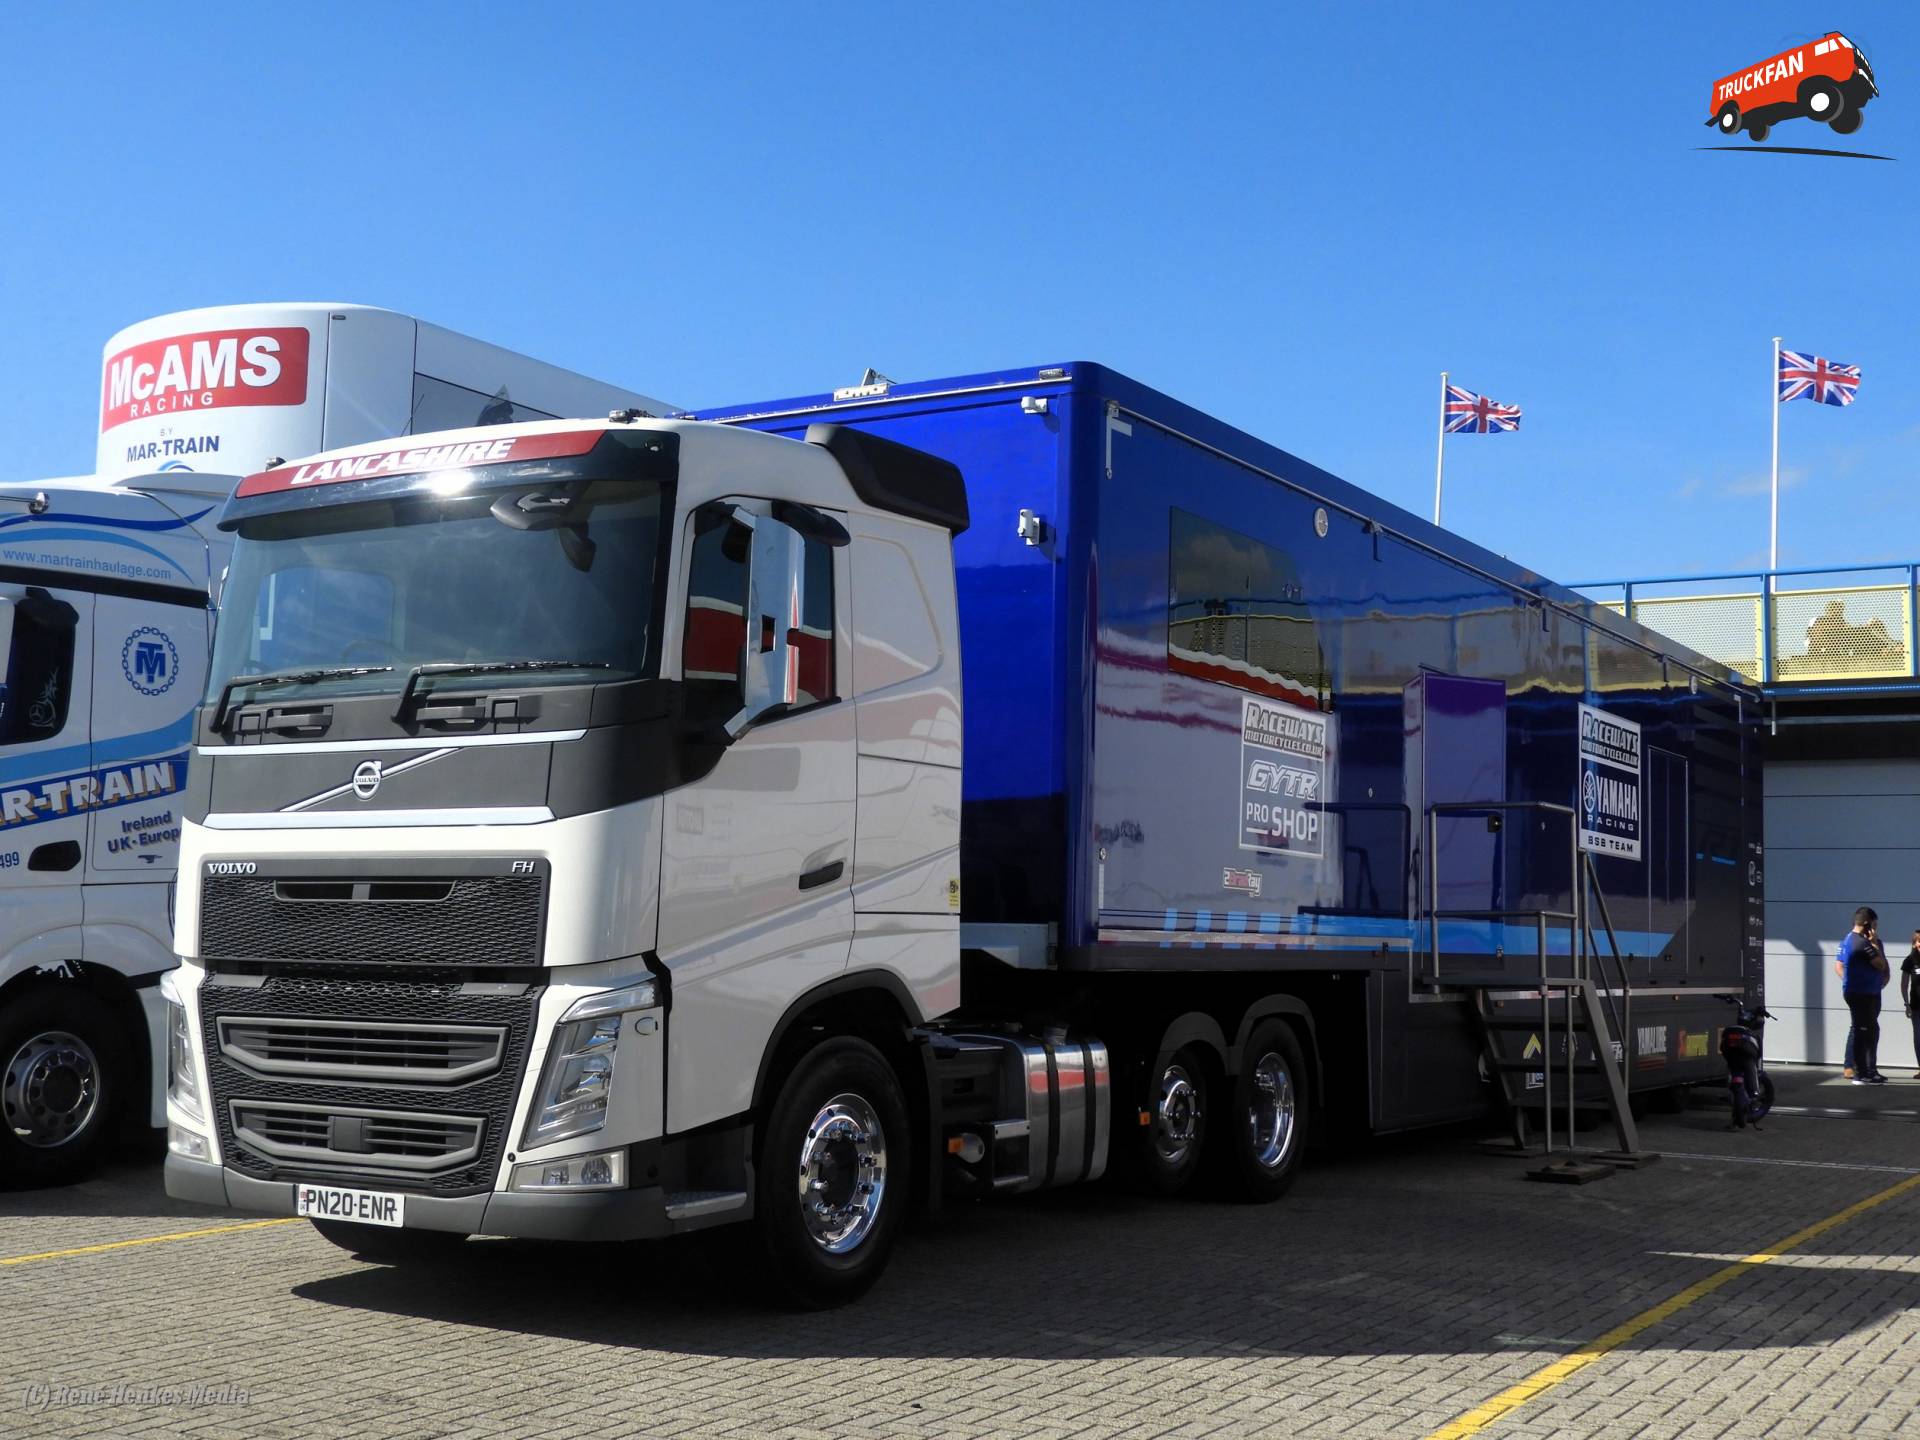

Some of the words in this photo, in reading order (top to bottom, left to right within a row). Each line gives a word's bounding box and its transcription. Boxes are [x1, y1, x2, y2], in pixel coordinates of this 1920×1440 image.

[109, 336, 282, 410] McAMS
[130, 391, 213, 418] RACING
[127, 435, 220, 463] MAR-TRAIN
[290, 438, 517, 484] LANCASHIRE
[3, 550, 172, 580] www.martrainhaulage.com
[1247, 703, 1324, 744] RACEWAYS
[1582, 711, 1639, 753] RACEWAYS
[1244, 729, 1323, 758] MOTORCYCLES.CO.UK
[0, 761, 176, 825] R-TRAIN
[354, 775, 379, 784] VOLVO
[1247, 760, 1320, 801] GYTR
[1596, 775, 1638, 821] YAMAHA
[121, 810, 173, 834] Ireland
[1246, 802, 1269, 824] PRO
[1271, 806, 1318, 842] SHOP
[1587, 815, 1634, 831] RACING
[1588, 835, 1606, 848] BSB
[1609, 840, 1633, 852] TEAM
[208, 862, 257, 874] VOLVO
[511, 860, 535, 873] FH
